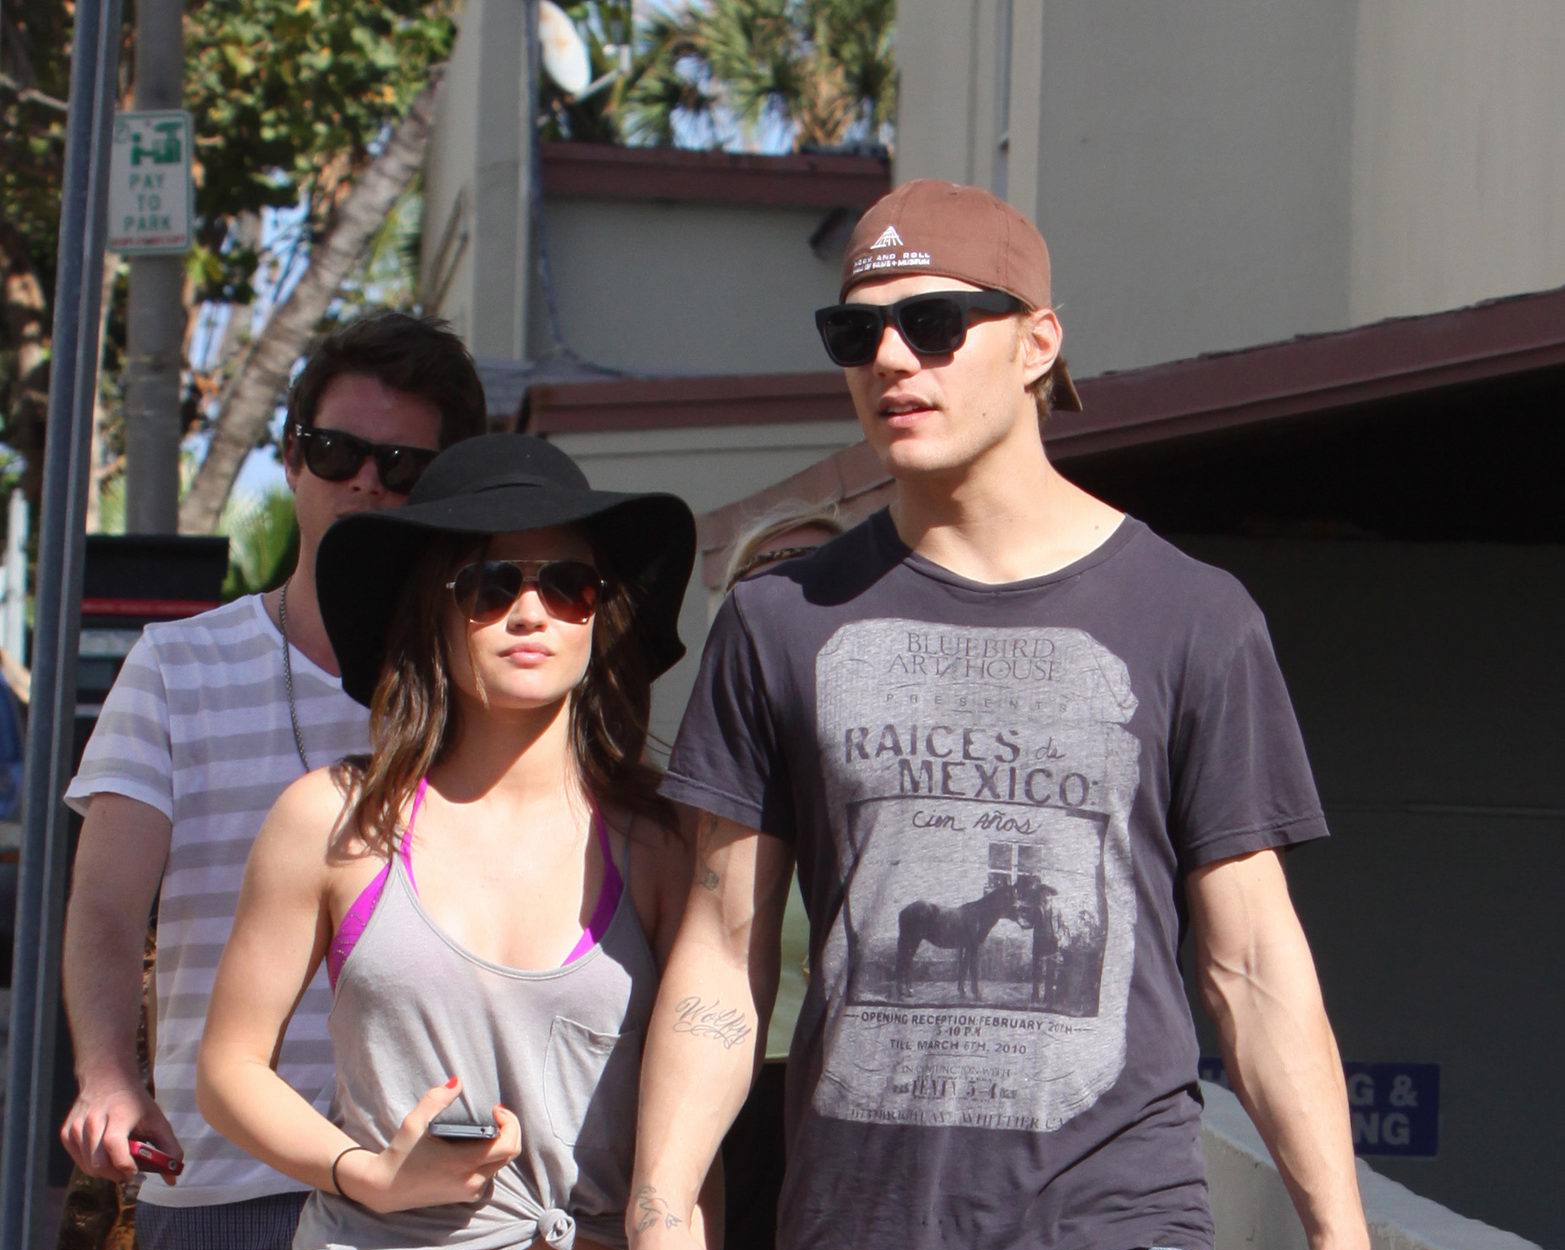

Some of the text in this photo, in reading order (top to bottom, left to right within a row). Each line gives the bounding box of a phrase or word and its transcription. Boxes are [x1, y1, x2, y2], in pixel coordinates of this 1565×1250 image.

[129, 173, 165, 189] PAY
[137, 194, 161, 211] TO
[123, 214, 171, 231] PARK
[876, 253, 896, 261] AND
[902, 251, 931, 259] ROLL
[907, 632, 1056, 660] BLUEBIRD
[964, 657, 1062, 682] HOUSE
[886, 693, 1068, 713] PRESENTS
[845, 724, 1066, 764] RAICES de
[861, 1011, 908, 1025] OPENING
[980, 1016, 1045, 1031] FEBRUARY
[890, 1039, 912, 1050] TILL
[917, 1040, 959, 1051] MARCH
[995, 1042, 1027, 1055] 2010
